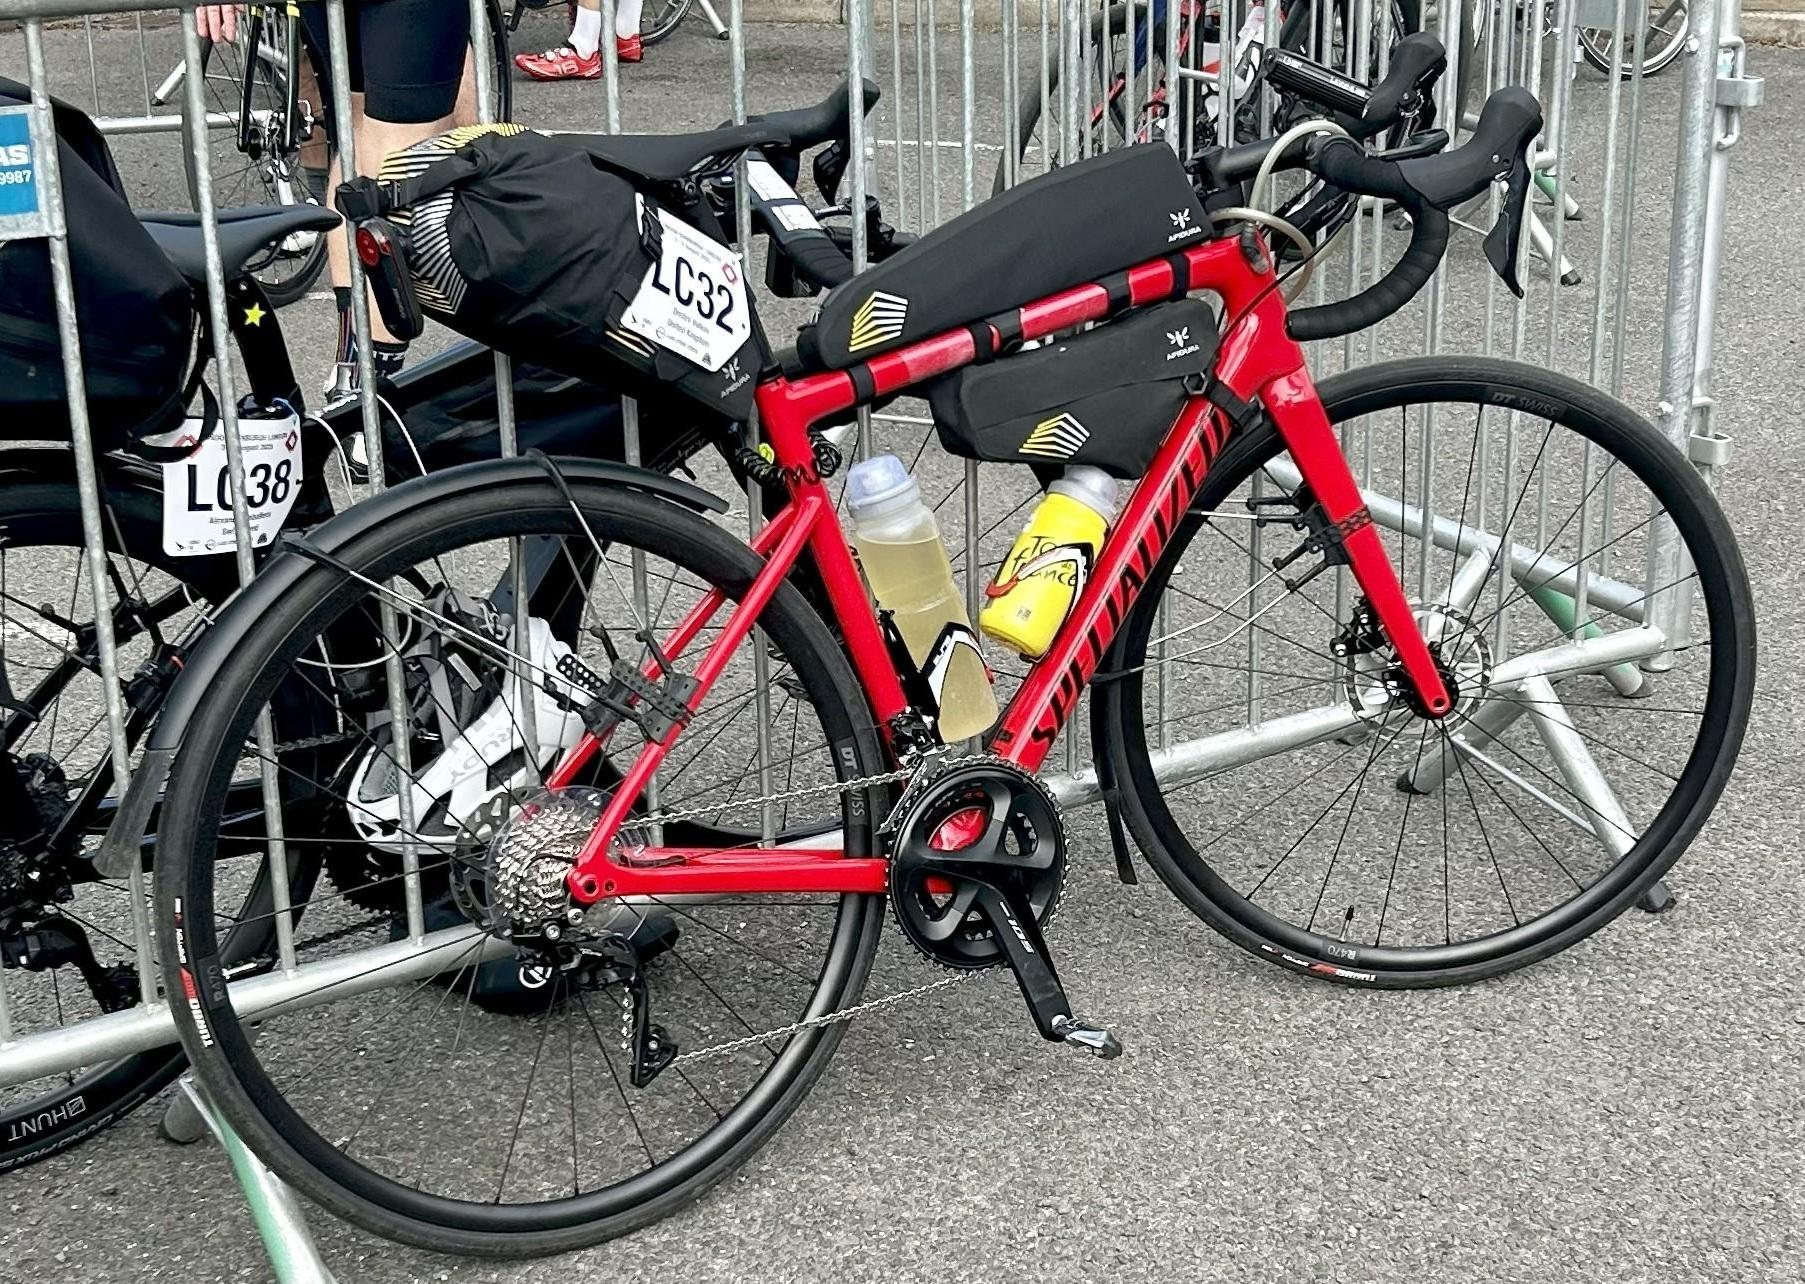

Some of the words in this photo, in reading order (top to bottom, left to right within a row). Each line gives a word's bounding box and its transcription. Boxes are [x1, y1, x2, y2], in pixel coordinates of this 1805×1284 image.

[1168, 226, 1202, 243] APIDURA
[651, 256, 734, 335] LC32
[1166, 344, 1200, 361] APIDURA
[187, 458, 292, 512] LC38
[841, 746, 859, 770] DT
[1007, 919, 1035, 954] 105
[1327, 944, 1357, 960] R470
[207, 964, 227, 1001] R470
[188, 997, 214, 1048] TURBO
[8, 1105, 68, 1142] HUNT
